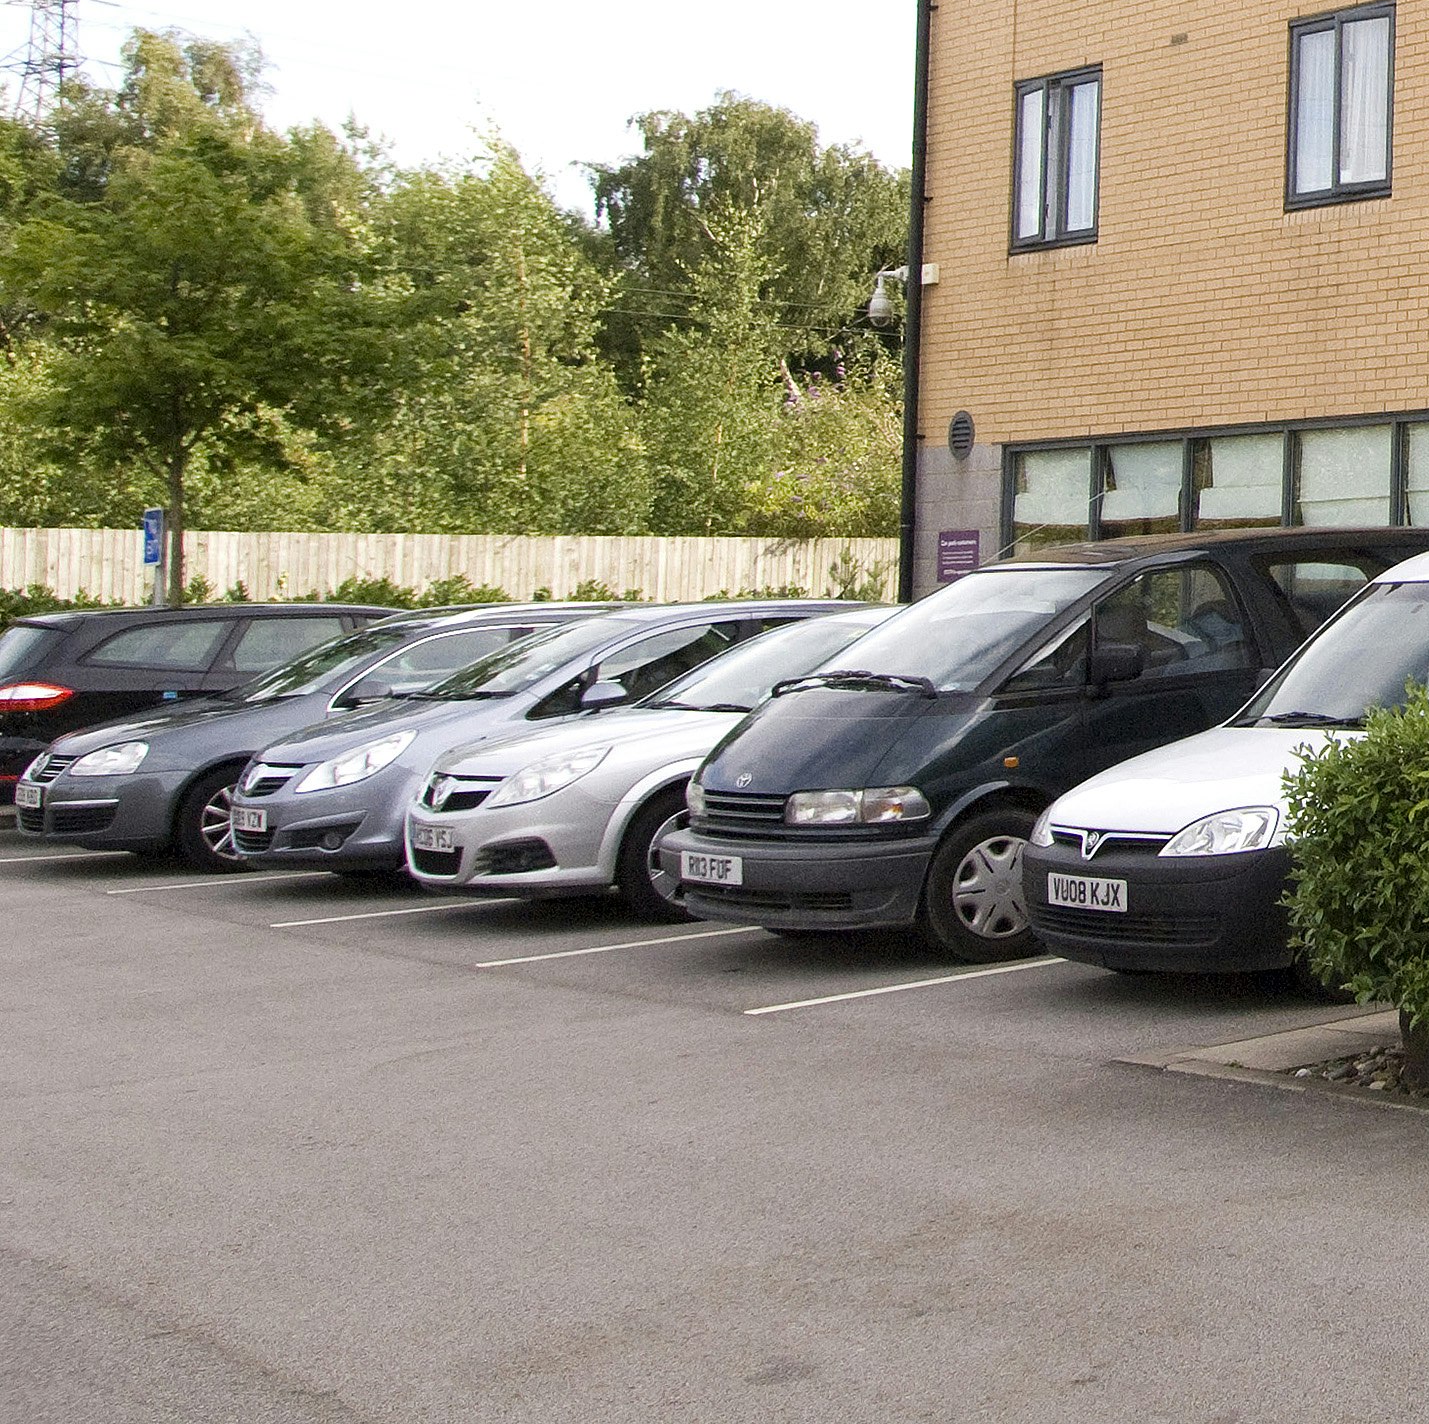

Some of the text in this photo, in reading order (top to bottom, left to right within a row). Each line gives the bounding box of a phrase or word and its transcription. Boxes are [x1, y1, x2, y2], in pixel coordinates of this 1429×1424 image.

[709, 858, 732, 880] FUF
[1053, 877, 1121, 907] VU08 KJX
